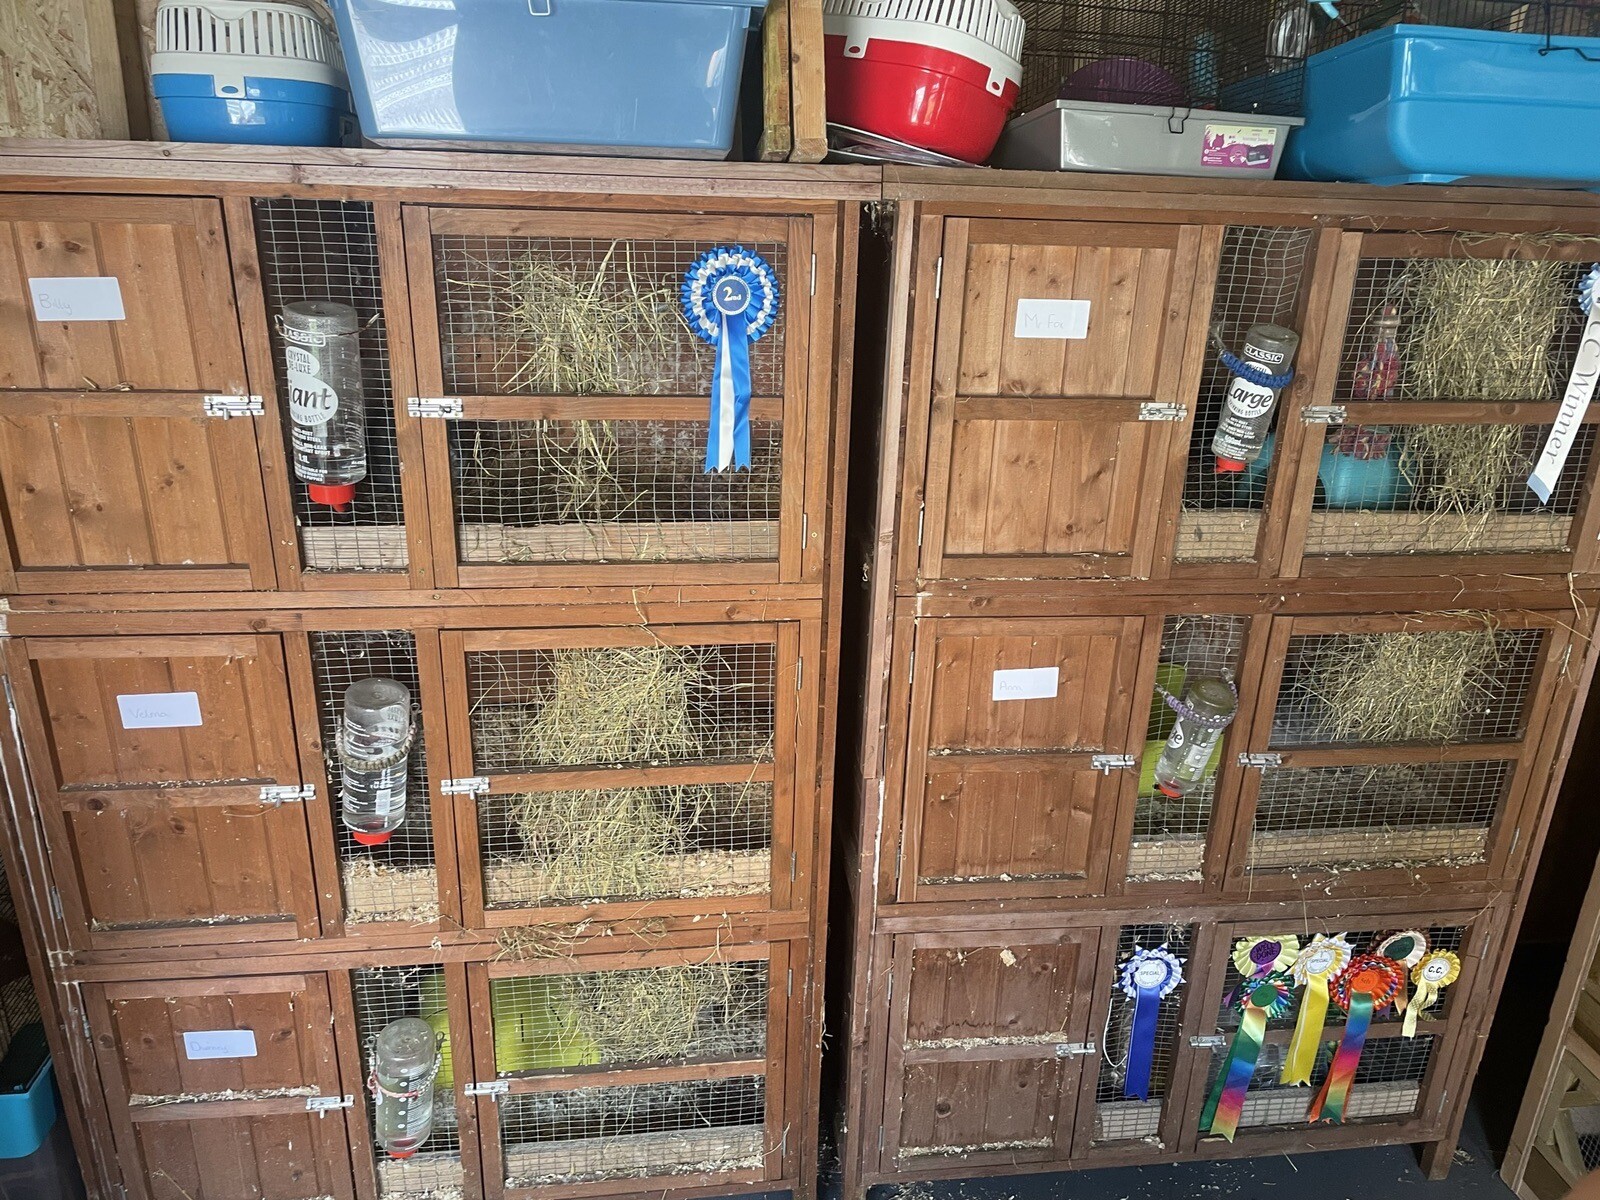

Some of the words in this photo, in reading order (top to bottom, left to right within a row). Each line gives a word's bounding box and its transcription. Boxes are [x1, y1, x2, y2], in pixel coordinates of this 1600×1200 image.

[1245, 345, 1282, 362] CLASSIC
[289, 379, 332, 410] iant
[1546, 365, 1598, 464] Winner
